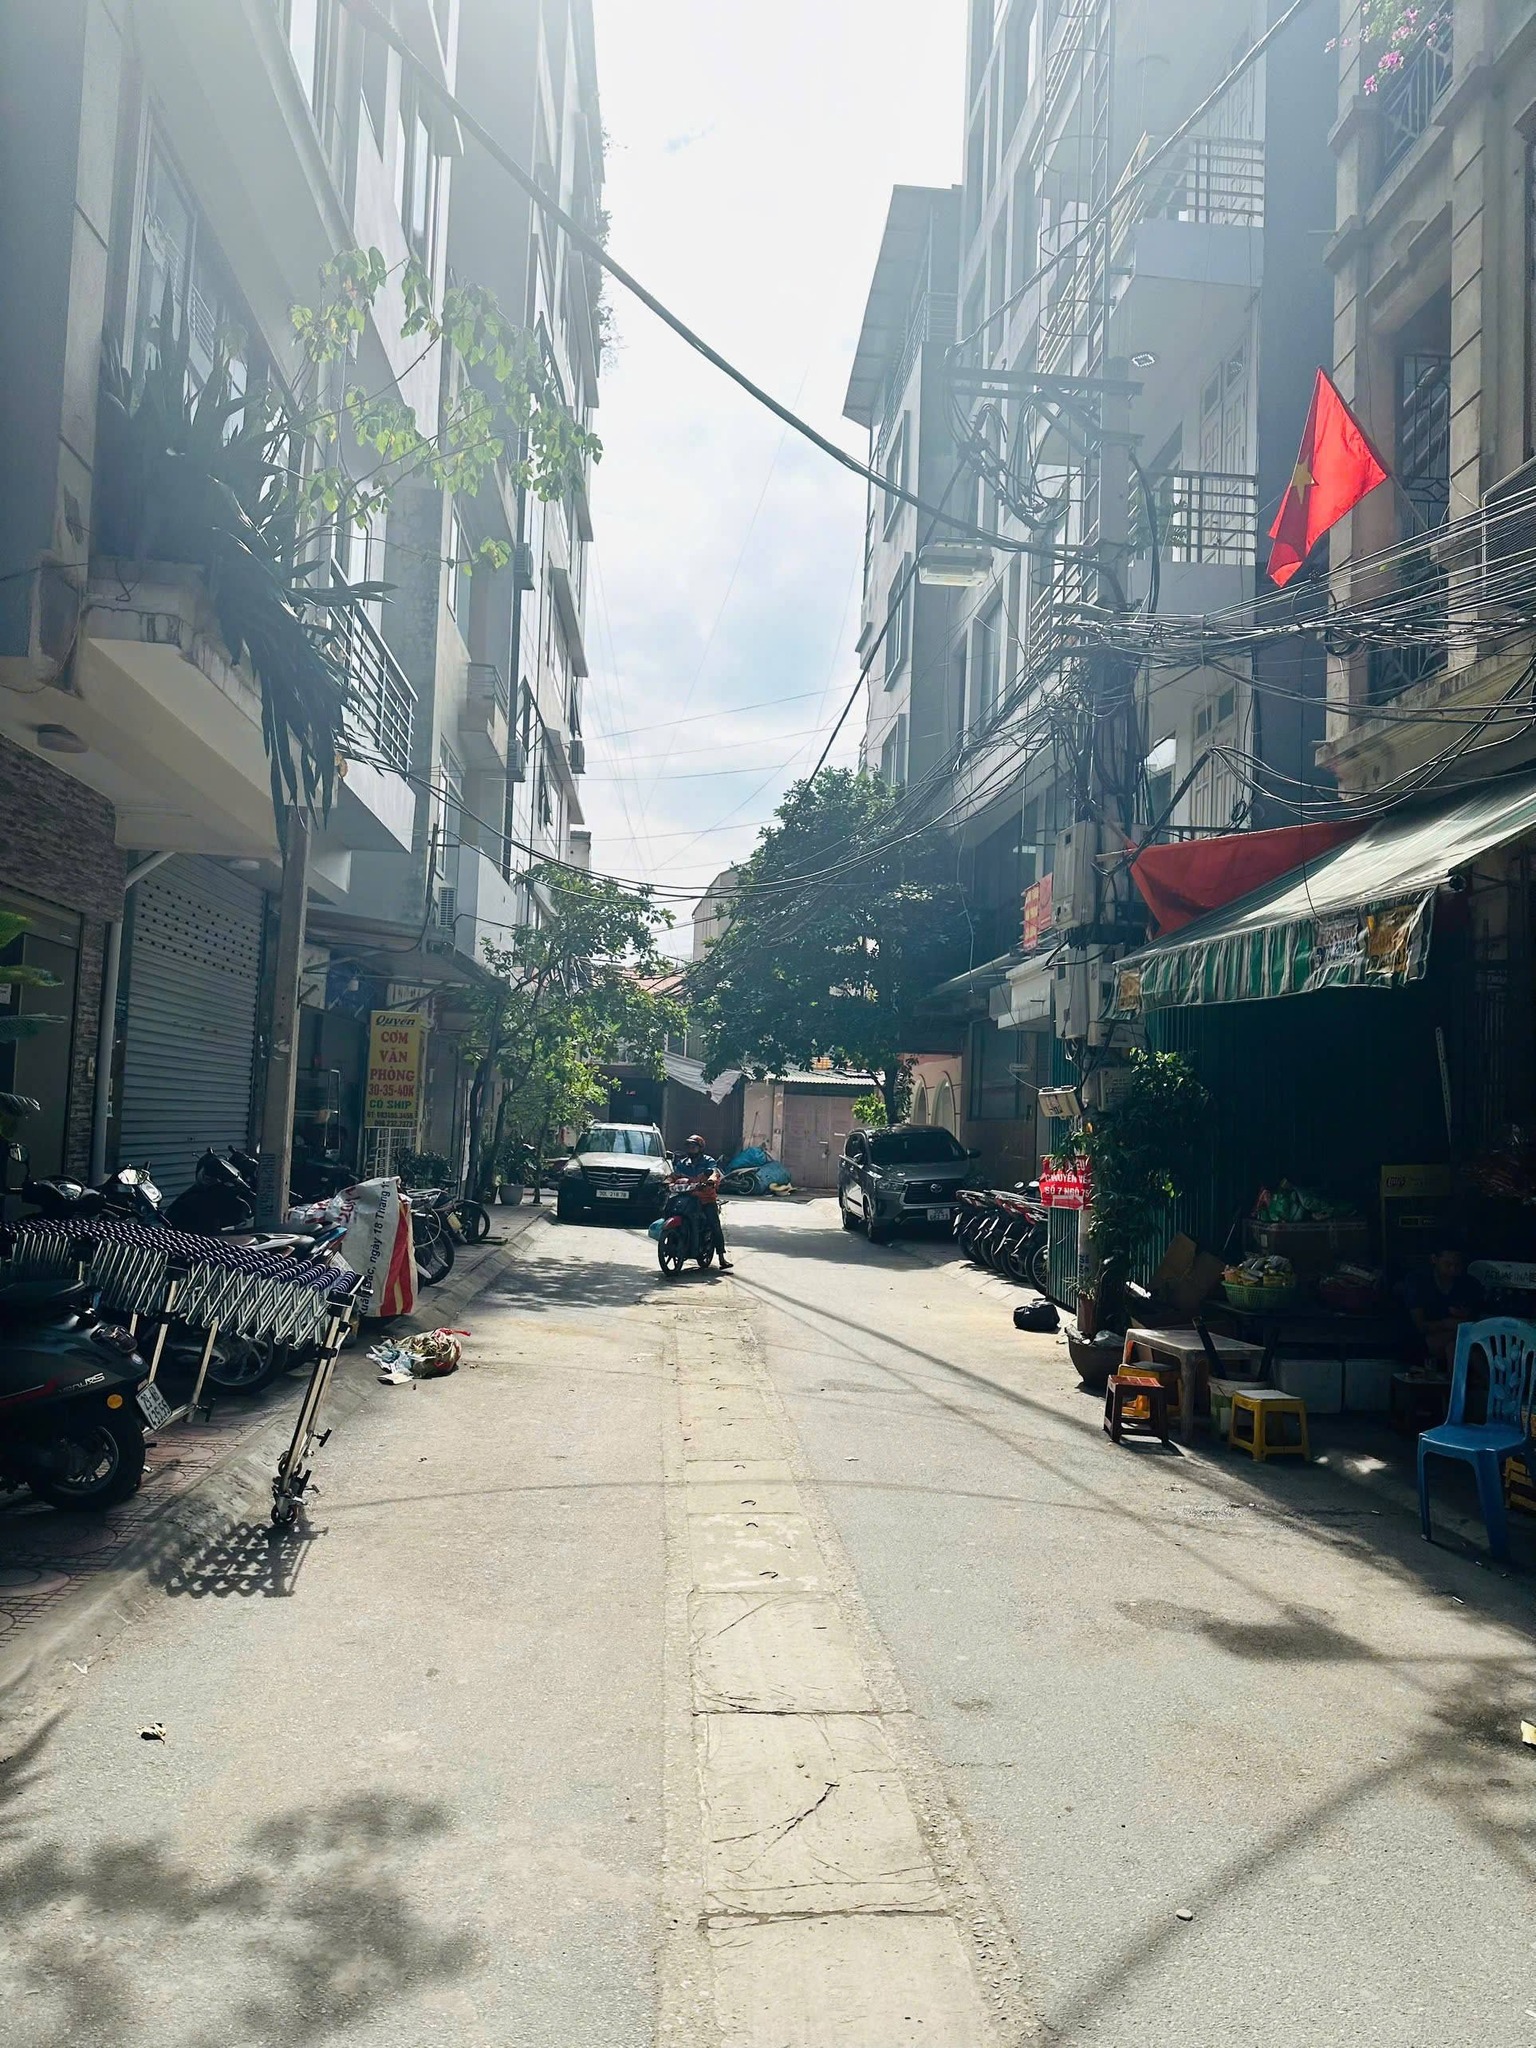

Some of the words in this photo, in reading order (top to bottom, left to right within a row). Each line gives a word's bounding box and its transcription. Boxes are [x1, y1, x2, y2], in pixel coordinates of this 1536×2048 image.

[381, 1030, 409, 1044] CƠM
[379, 1047, 408, 1062] VĂN
[369, 1065, 415, 1081] PHÒNG
[368, 1083, 415, 1097] 30-35-40K
[387, 1100, 412, 1109] SHIP
[1057, 1187, 1064, 1195] 7
[373, 1222, 384, 1237] 18
[370, 1237, 384, 1264] ngày
